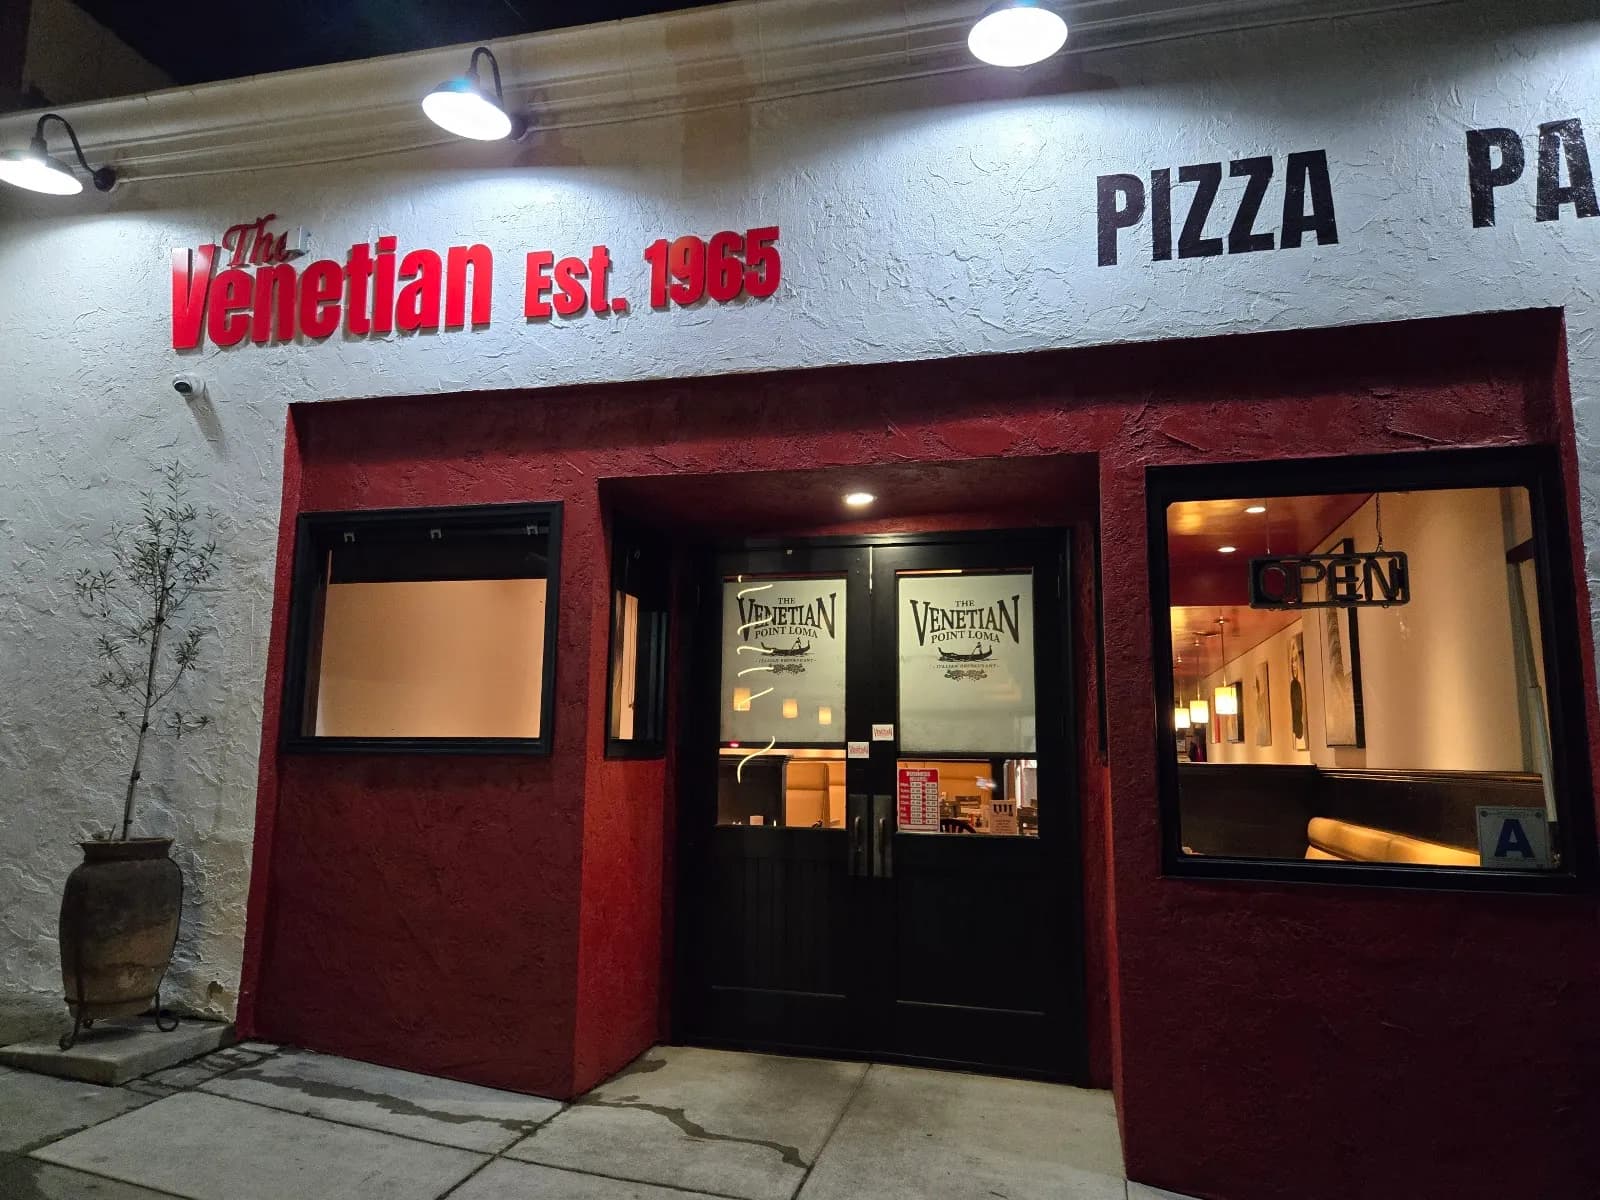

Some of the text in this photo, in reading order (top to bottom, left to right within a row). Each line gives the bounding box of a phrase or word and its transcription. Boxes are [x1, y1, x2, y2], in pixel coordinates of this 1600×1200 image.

[1096, 117, 1600, 267] PIZZA PA
[222, 213, 305, 267] The
[172, 226, 781, 349] Venetian Est. 1965
[778, 597, 795, 605] THE
[1259, 557, 1402, 602] OPEN
[736, 592, 836, 641] VENETIAN
[754, 626, 818, 639] POINT LOMA
[909, 594, 1020, 646] VENETIAN
[931, 630, 1001, 643] POINT LOMA
[1494, 819, 1536, 858] A
